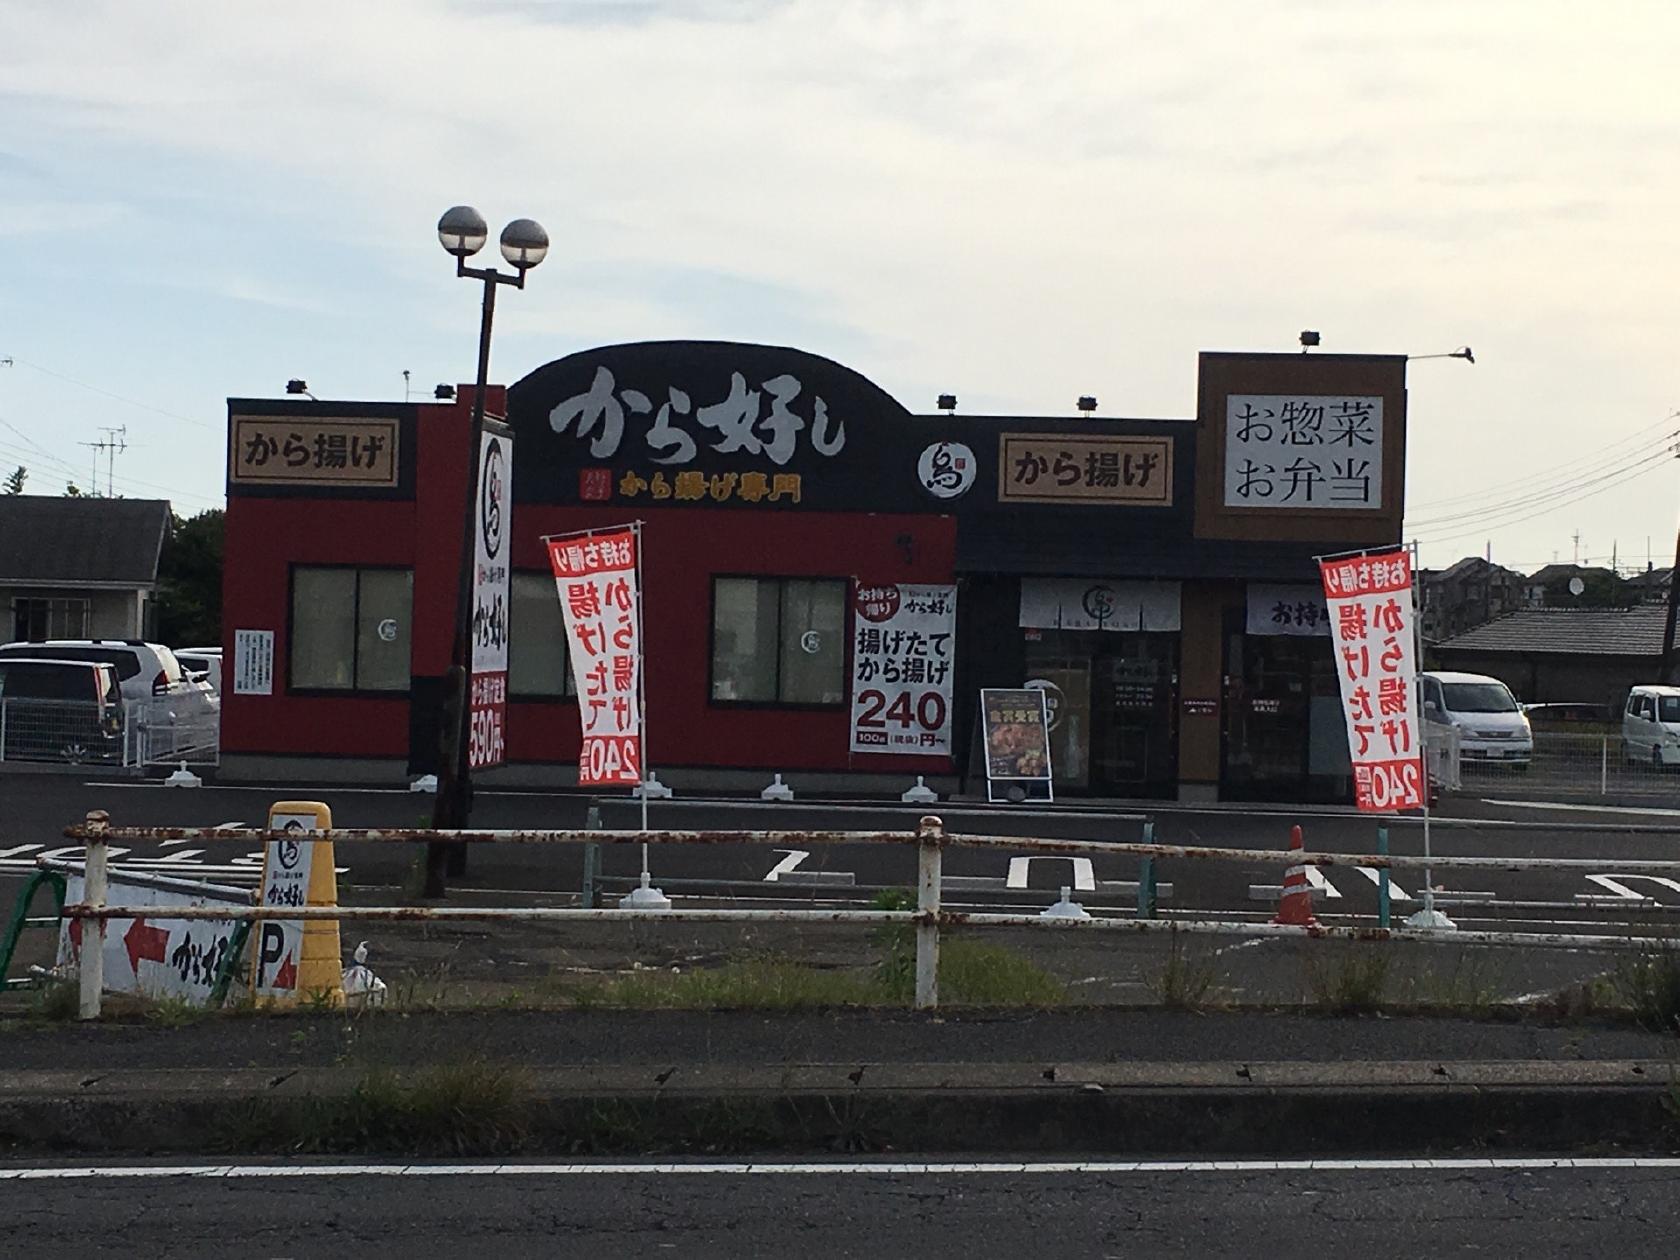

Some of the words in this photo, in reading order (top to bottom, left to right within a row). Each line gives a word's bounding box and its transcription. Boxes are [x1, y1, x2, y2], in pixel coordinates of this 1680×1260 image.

[549, 365, 846, 466] から好し
[1236, 400, 1375, 448] お惣菜
[246, 432, 385, 470] から揚げ
[1014, 450, 1159, 488] から揚げ
[1236, 457, 1371, 504] お弁当
[857, 627, 951, 657] 揚げたて
[857, 657, 950, 685] から揚げ
[856, 689, 947, 731] 240
[469, 708, 494, 767] 590
[257, 923, 285, 988] P
